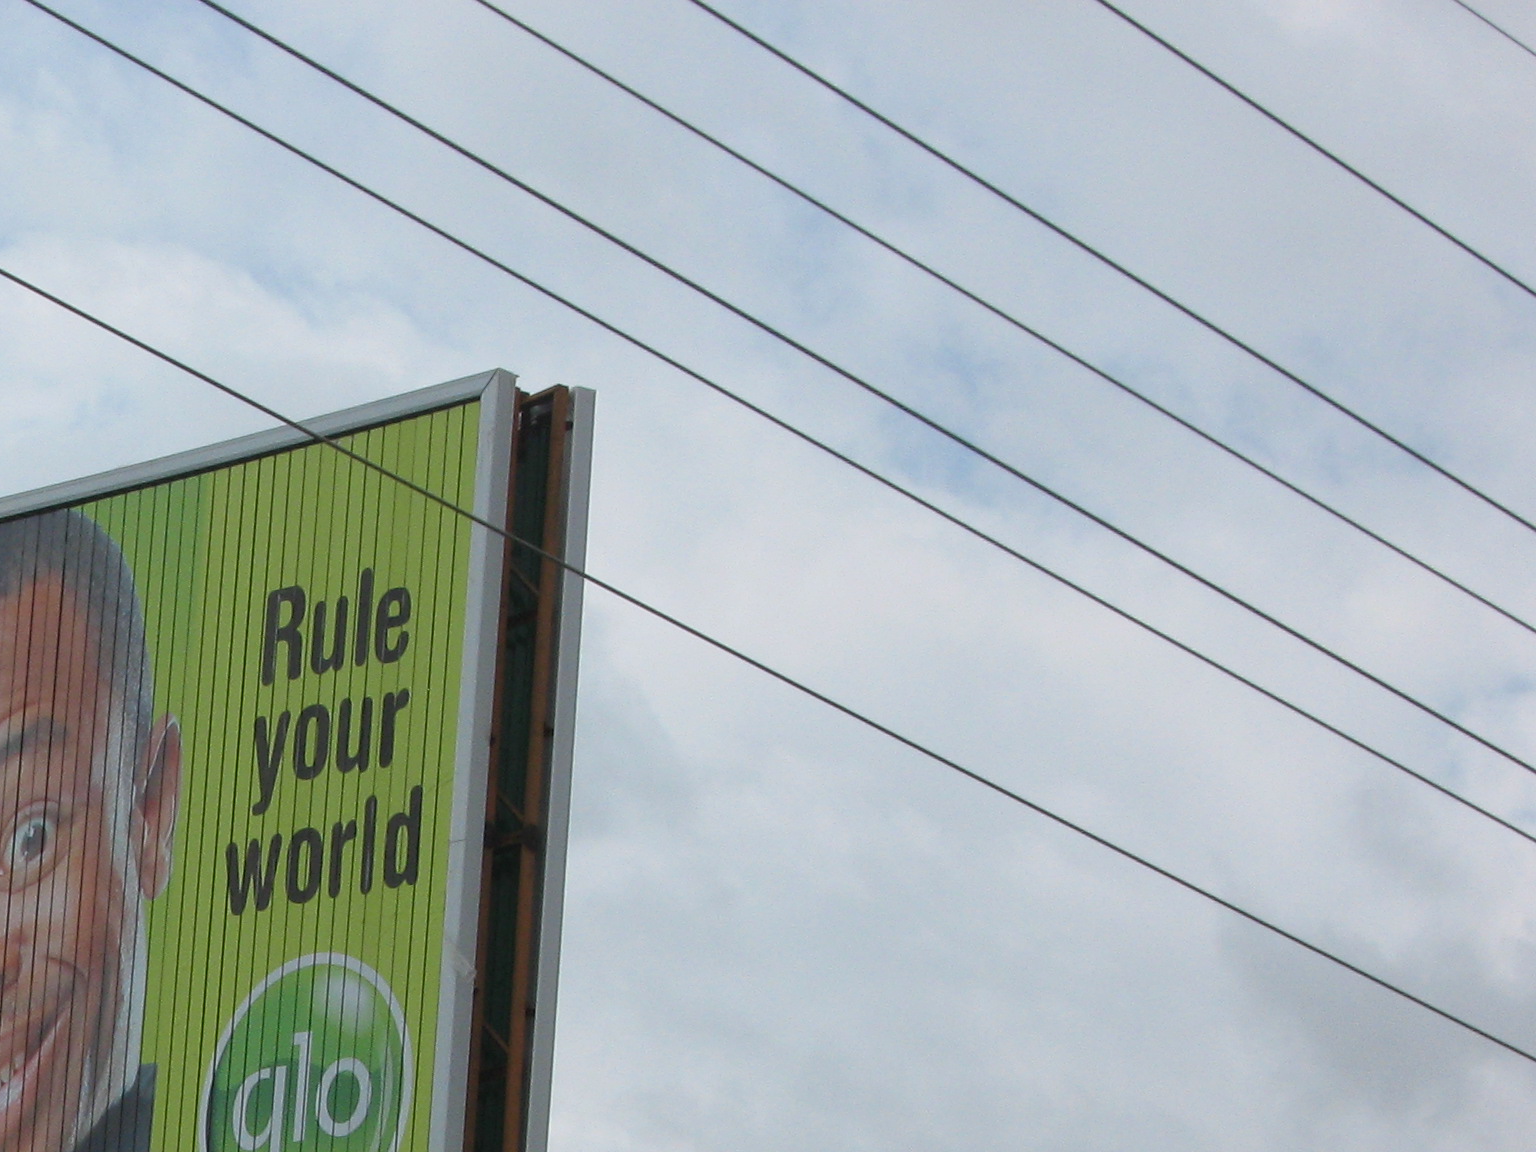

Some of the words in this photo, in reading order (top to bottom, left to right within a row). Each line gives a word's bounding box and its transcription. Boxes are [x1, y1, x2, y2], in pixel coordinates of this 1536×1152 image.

[261, 567, 412, 686] Rule
[252, 688, 410, 815] your
[225, 786, 425, 917] world
